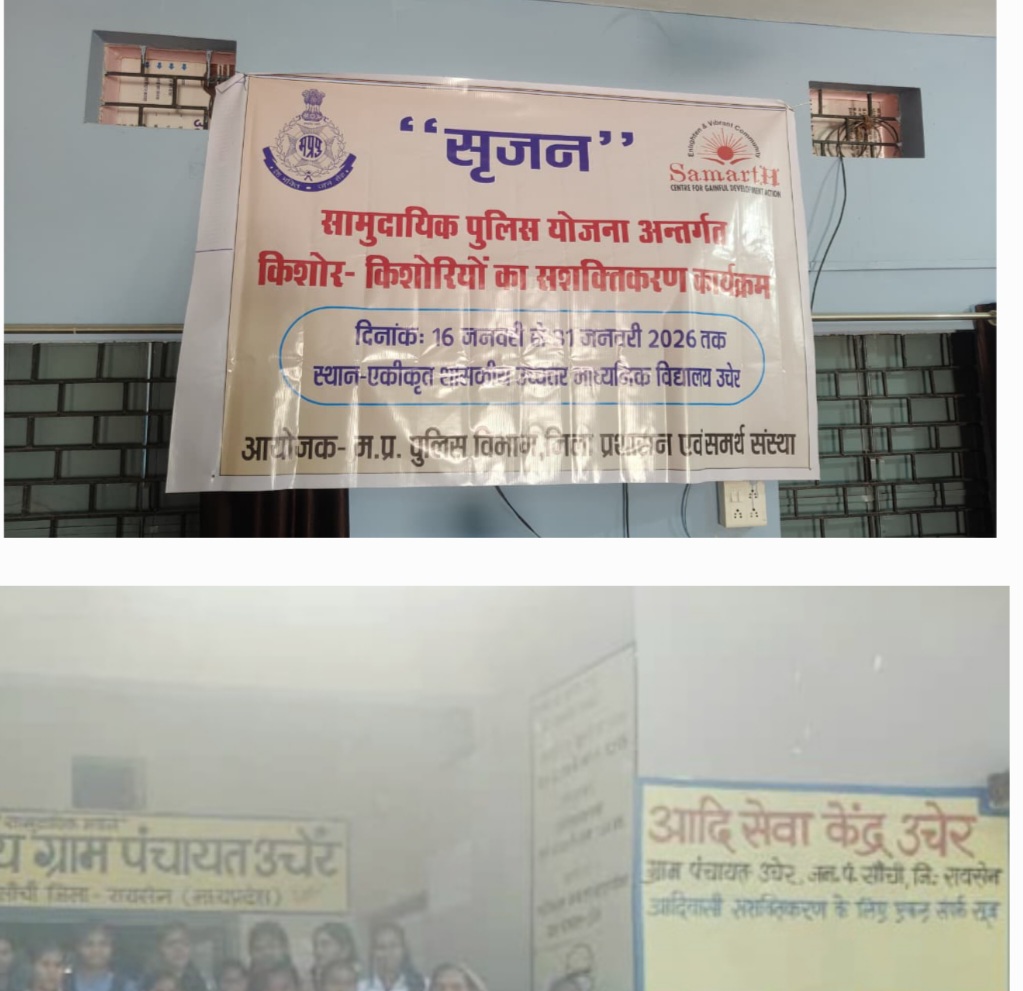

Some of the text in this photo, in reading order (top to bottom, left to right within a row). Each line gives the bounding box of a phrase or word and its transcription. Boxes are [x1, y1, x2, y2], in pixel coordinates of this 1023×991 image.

[687, 127, 702, 158] Enlighten
[707, 120, 734, 128] Vibrant
[734, 125, 761, 159] Community
[670, 184, 691, 192] CENTRE
[692, 184, 704, 192] FOR
[704, 184, 729, 193] GAINFUL
[764, 189, 782, 199] ACTION
[321, 206, 728, 250] सामुदायिक पुलिस योजना अन्तर्गत
[258, 250, 772, 300] किशोर- किशोरियों का सशक्तिकरण कार्यक्रम
[432, 327, 455, 347] 16
[460, 320, 525, 348] जनवरी
[580, 321, 642, 348] जनवरी
[648, 329, 697, 349] 2026
[700, 330, 728, 350] तक
[656, 360, 712, 388] विद्यालय
[715, 362, 742, 388] उचेर
[241, 427, 347, 461] आयोजक-
[354, 435, 402, 460] म.प्र.
[409, 427, 468, 467] पुलिस
[749, 428, 796, 457] संस्था
[649, 796, 735, 854] आदि
[739, 798, 815, 849] सेवा
[821, 801, 893, 858] केंद्र
[897, 801, 978, 858] उचेर
[30, 835, 114, 878] ग्राम
[119, 826, 253, 876] पंचायत
[641, 860, 684, 884] ग्राम
[688, 856, 752, 884] पंचायत
